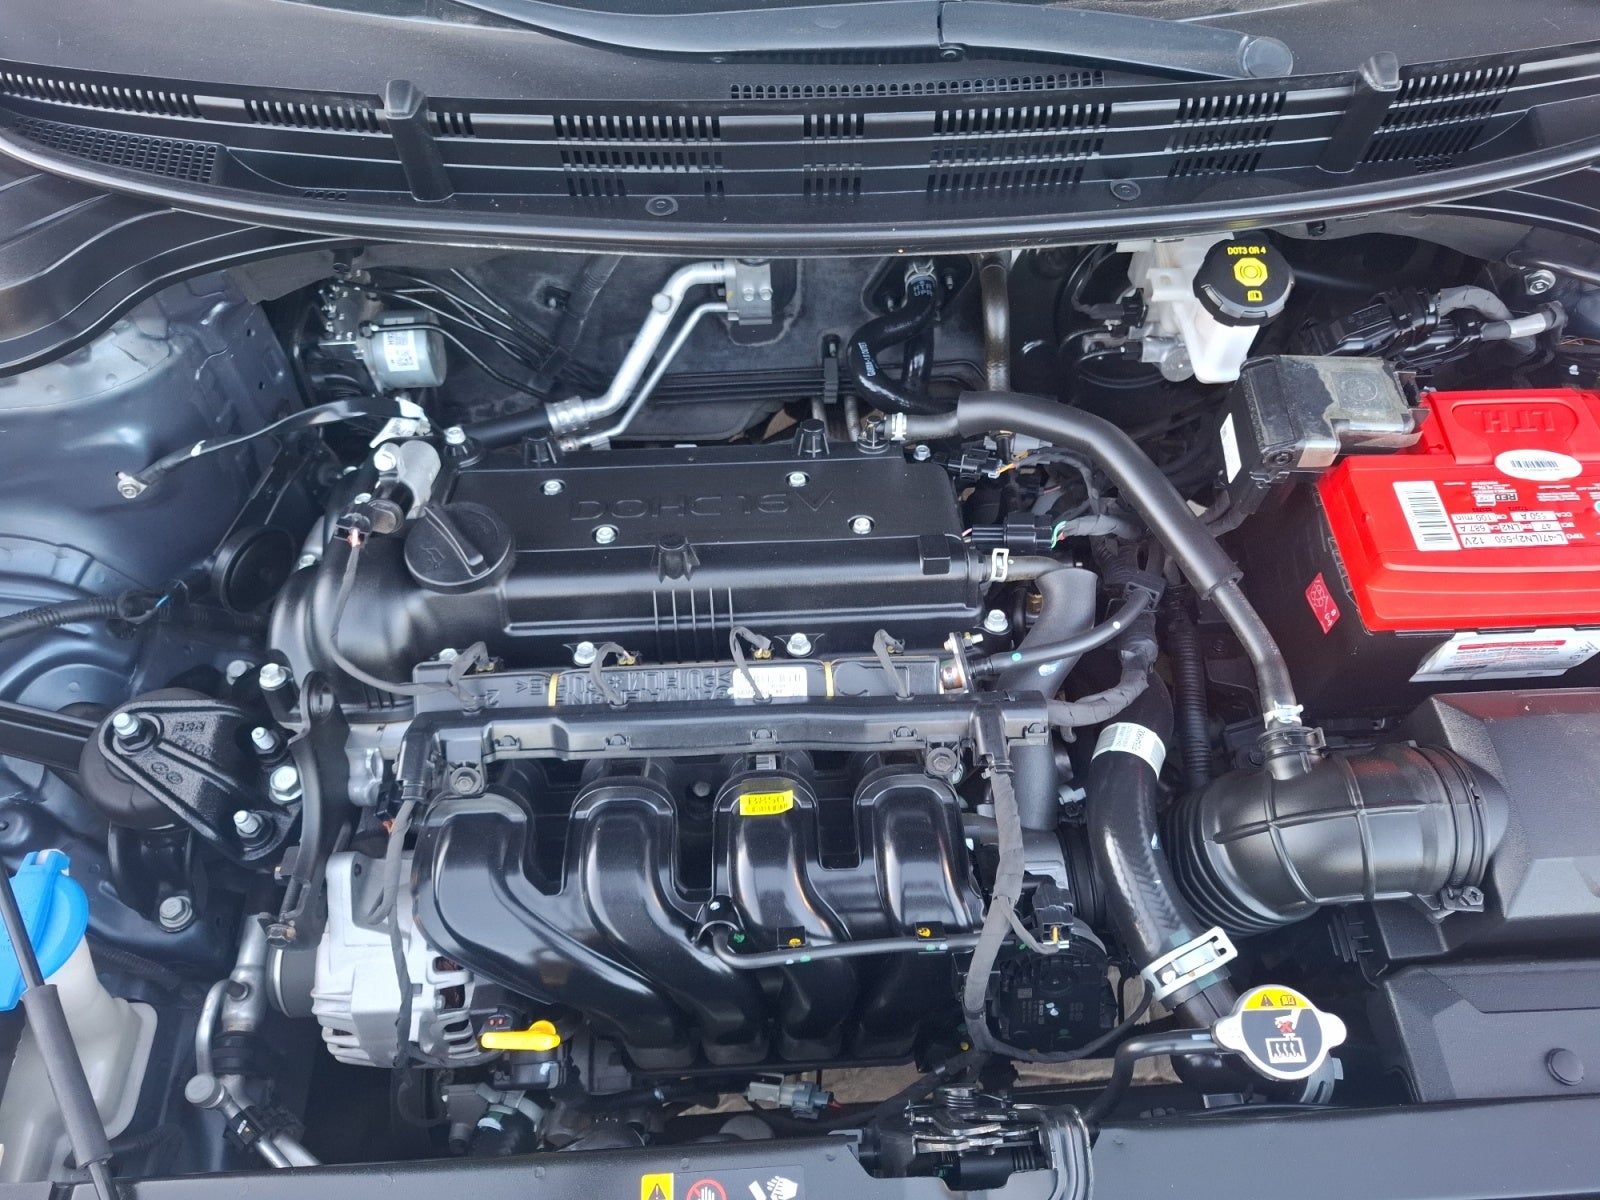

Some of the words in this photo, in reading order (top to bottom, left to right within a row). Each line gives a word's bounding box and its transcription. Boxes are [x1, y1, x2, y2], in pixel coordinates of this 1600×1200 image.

[1227, 246, 1247, 255] DOT3
[1248, 246, 1260, 254] OR
[1260, 246, 1266, 254] 4
[1483, 411, 1555, 432] LTH
[571, 496, 722, 521] DOHC
[735, 489, 835, 516] 16V
[1501, 522, 1521, 532] LN2
[1463, 536, 1485, 546] 12V
[1493, 533, 1565, 545] L-47(LN2)-550
